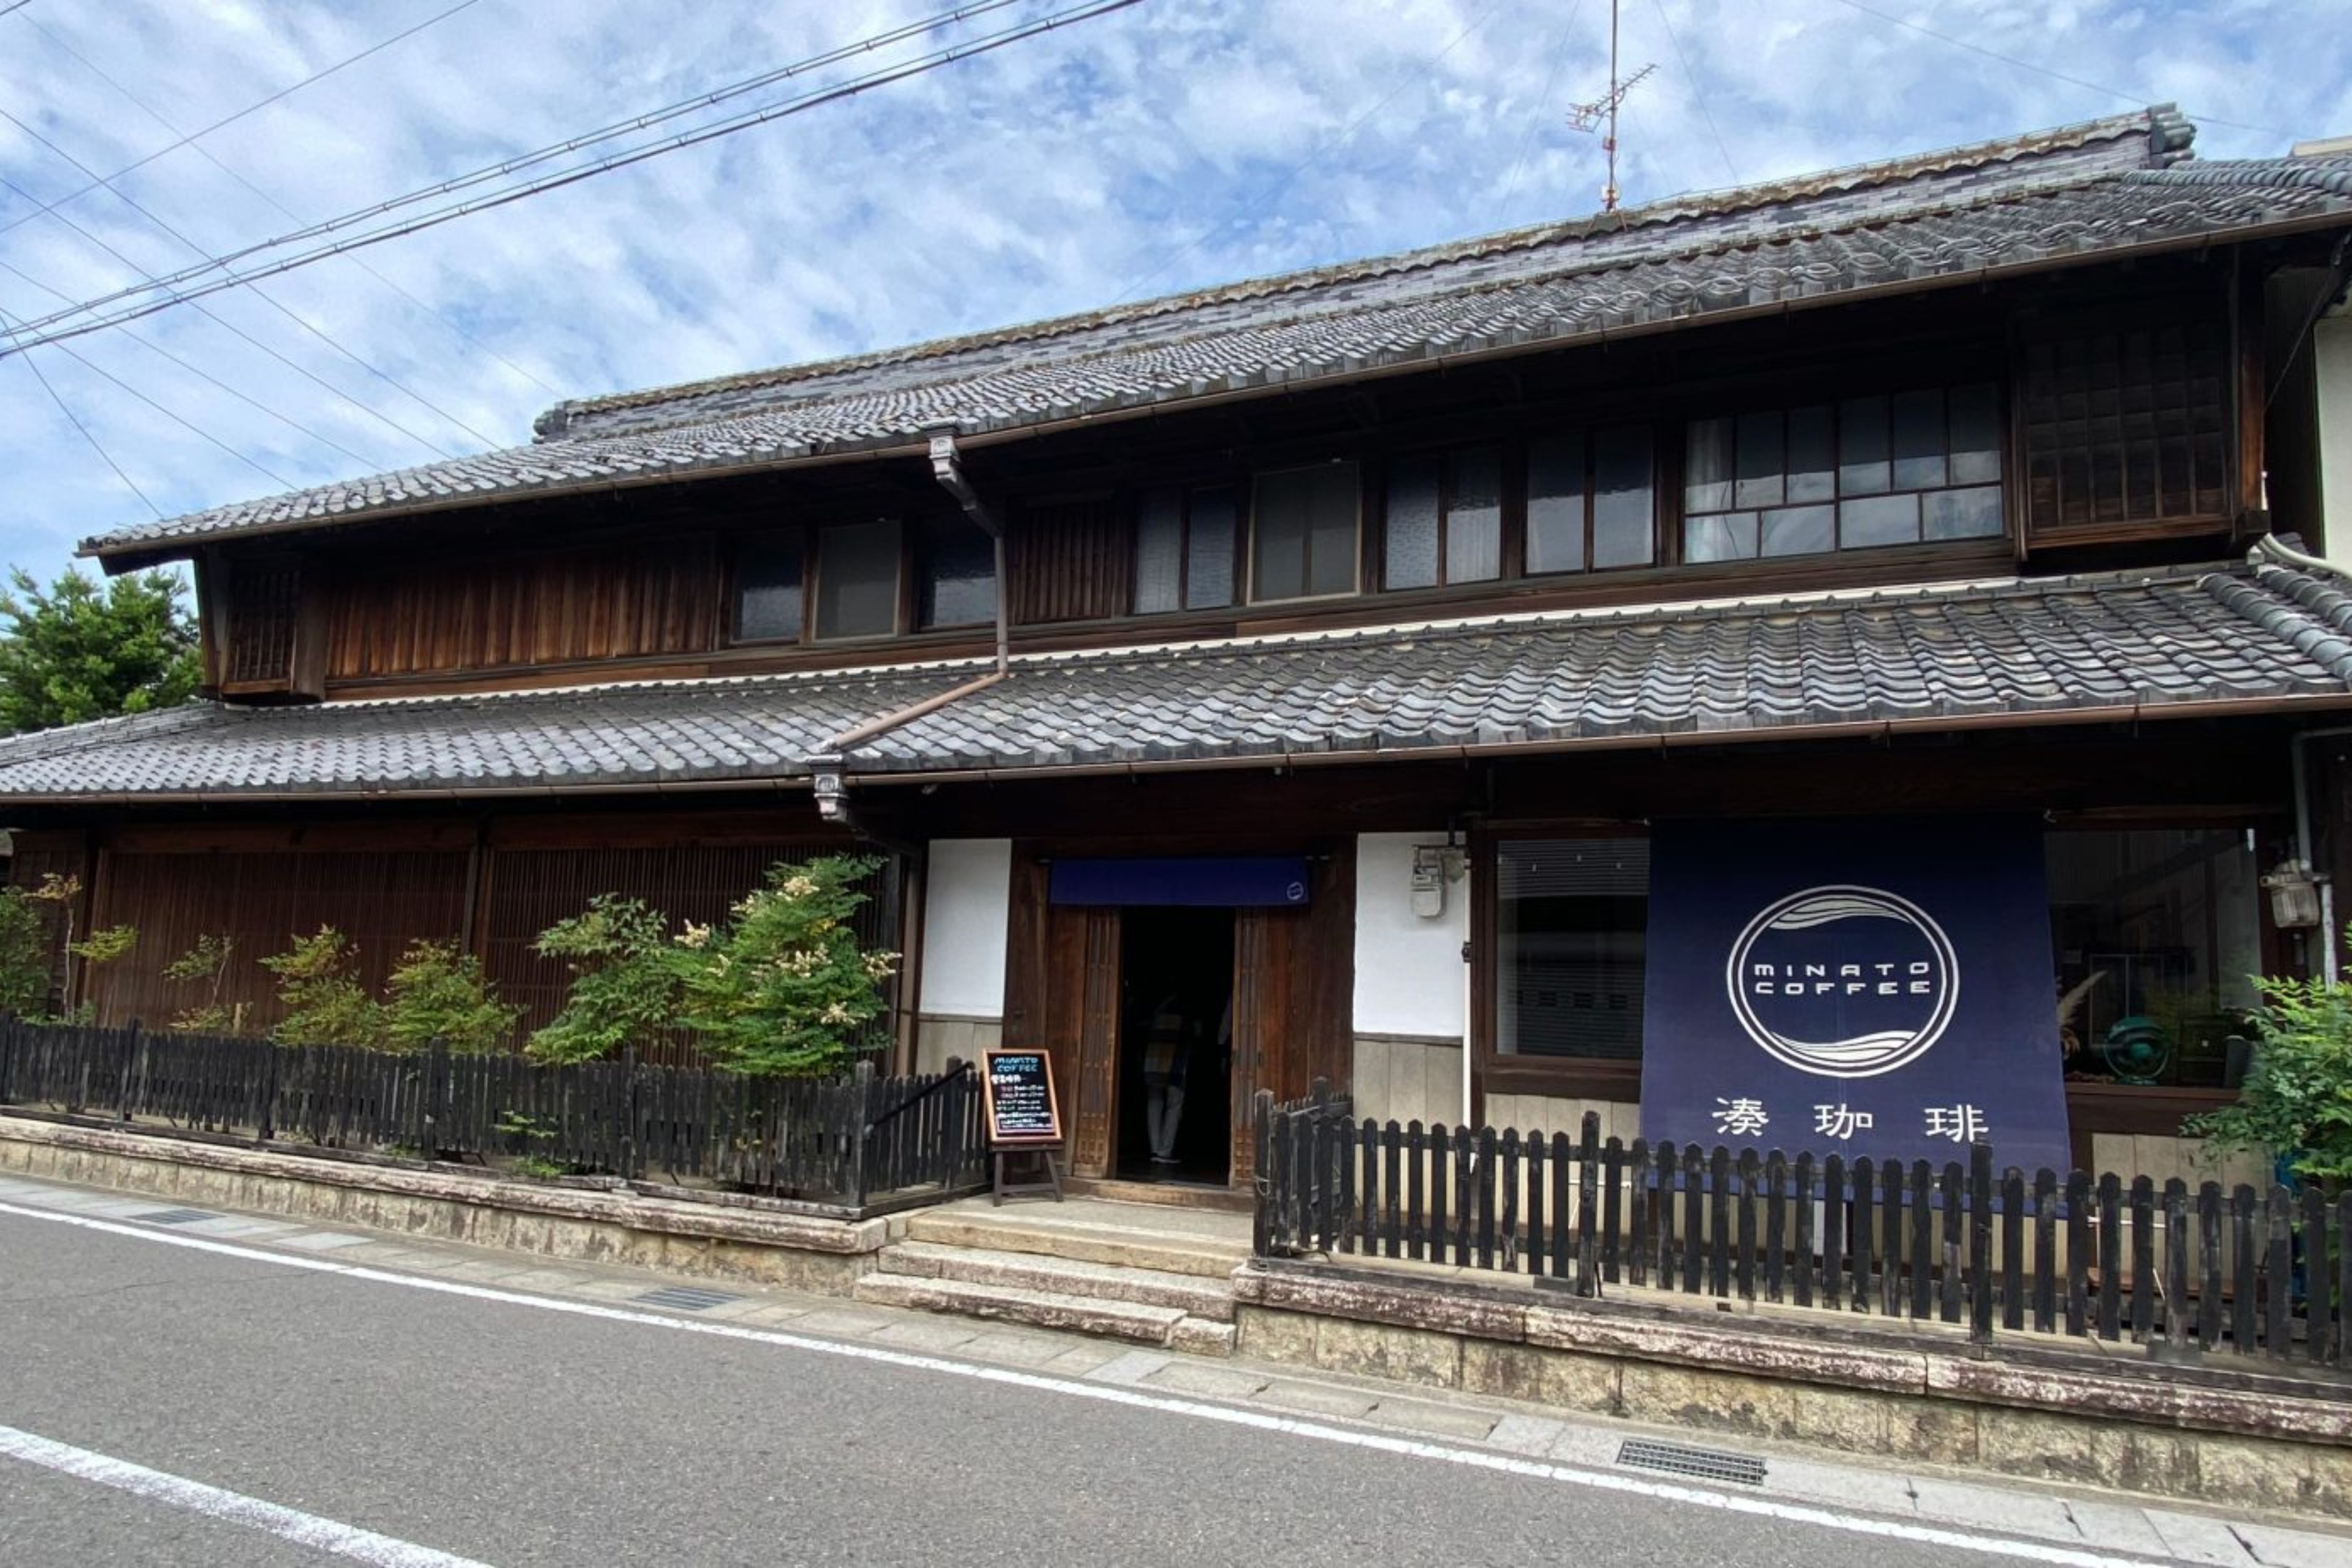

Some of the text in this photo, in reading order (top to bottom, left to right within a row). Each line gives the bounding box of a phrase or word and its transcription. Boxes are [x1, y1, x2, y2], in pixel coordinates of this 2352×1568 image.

[1754, 962, 1929, 977] MINATO
[1755, 981, 1930, 995] COFFEE
[1712, 1098, 1989, 1143] 湊珈琲
